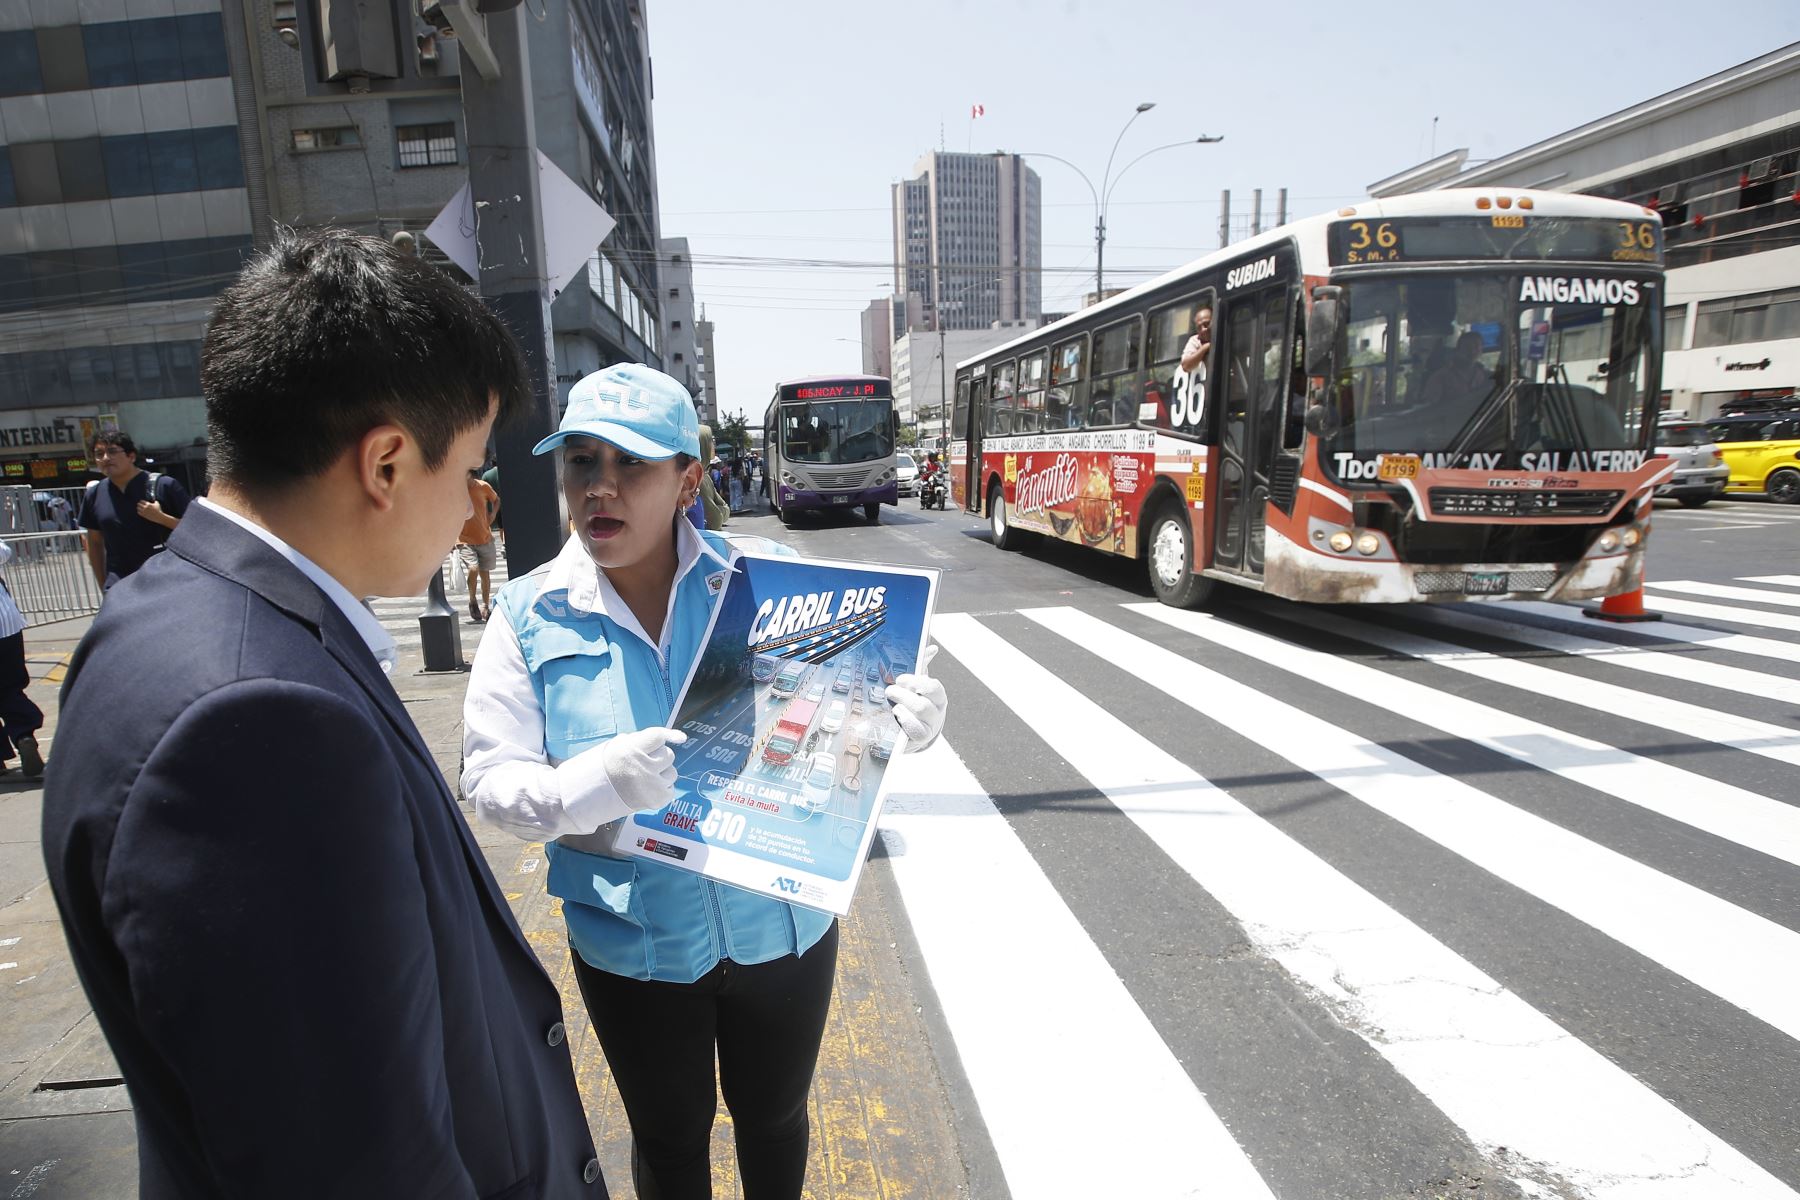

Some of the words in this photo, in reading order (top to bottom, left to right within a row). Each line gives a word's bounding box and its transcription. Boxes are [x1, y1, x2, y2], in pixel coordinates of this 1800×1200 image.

[1495, 216, 1522, 226] 1199
[1349, 222, 1397, 249] 36
[1616, 222, 1656, 249] 36
[1225, 255, 1276, 291] SUBIDA
[1519, 276, 1640, 305] ANGAMOS
[1171, 360, 1207, 427] 36
[0, 425, 75, 447] NTERNET
[1069, 435, 1091, 449] ANGAMOS
[1094, 433, 1127, 449] CHORRILLOS
[1385, 464, 1416, 476] 1199
[1015, 453, 1078, 517] Panquita
[1188, 486, 1202, 498] 1199
[747, 591, 834, 647] CARRIL
[836, 585, 887, 621] BUS
[705, 745, 739, 764] BUS
[707, 773, 744, 791] RESPETA
[745, 783, 756, 795] EL
[757, 786, 787, 803] CARRIL
[668, 799, 703, 818] MULTA
[724, 791, 746, 804] Evita
[746, 797, 754, 807] la
[756, 801, 780, 813] multa
[663, 812, 699, 832] GRAVE
[702, 808, 746, 844] G10
[770, 876, 802, 894] ATU
